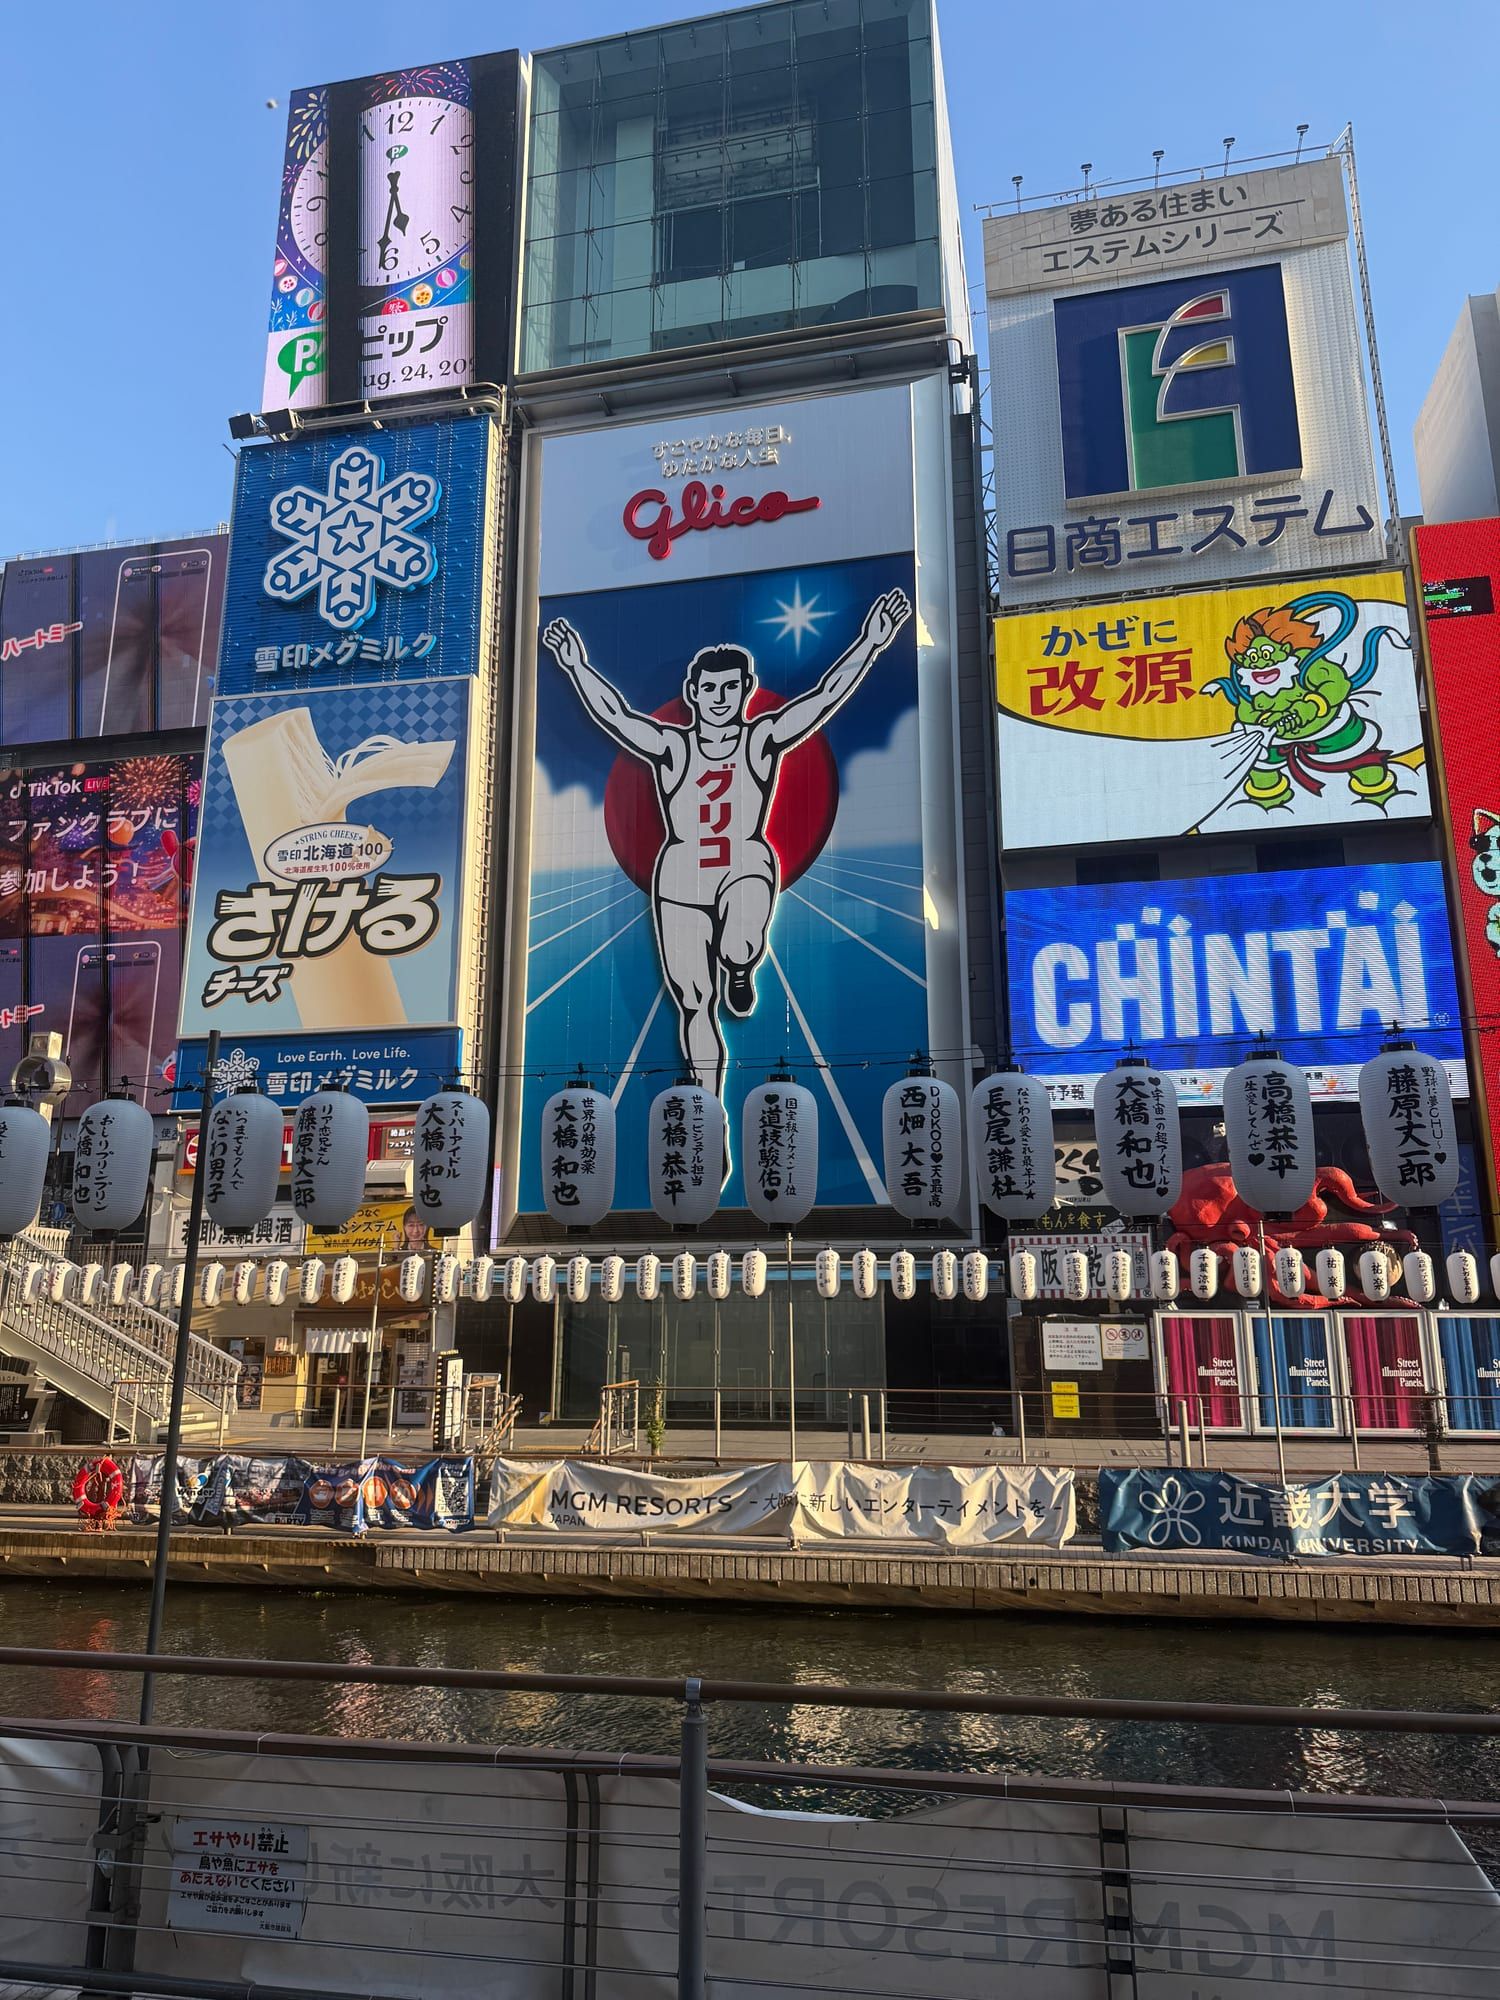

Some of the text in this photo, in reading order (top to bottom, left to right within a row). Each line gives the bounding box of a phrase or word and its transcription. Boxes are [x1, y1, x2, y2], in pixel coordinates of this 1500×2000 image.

[385, 110, 414, 134] 12
[429, 115, 446, 136] 1
[450, 203, 473, 224] 4
[1069, 185, 1248, 235] 夢ある住まい
[382, 248, 399, 271] 6
[420, 230, 441, 255] 5
[1042, 210, 1287, 274] エステムシリーズ
[362, 315, 449, 362] ピップ
[363, 372, 396, 390] ug.
[400, 363, 433, 382] 24,
[662, 446, 779, 478] ゆたかな人生
[1007, 489, 1374, 579] 日商エステム
[0, 621, 83, 661] ハートミー
[254, 631, 437, 673] 雪印メグミルク
[1041, 614, 1178, 658] かぜに
[1026, 646, 1200, 717] 改源
[29, 778, 109, 798] TikTok LIVE
[8, 806, 179, 842] ファンクラブに
[299, 829, 359, 845] STRING CHEESE
[695, 763, 737, 870] グリコ
[207, 873, 442, 962] さける
[202, 964, 294, 1008] チーズ
[277, 1046, 411, 1064] Love Earth. Love Life.
[267, 1065, 419, 1096] 雪印メグミルク
[316, 1103, 334, 1166] リア恋兄さん
[446, 1100, 465, 1179] スーパーアイドル
[581, 1097, 597, 1175] 世界の特効薬
[899, 1085, 927, 1197] 西畑大吾
[982, 1086, 1024, 1200] 長尾謙杜
[1114, 1076, 1156, 1189] 大橋和也
[1261, 1070, 1298, 1180] 高橋恭平
[1387, 1064, 1436, 1188] 藤原丈一郎
[74, 1115, 97, 1204] 大橋和也
[207, 1109, 233, 1204] なにわ男子
[295, 1105, 318, 1210] 藤原丈一郎
[419, 1102, 446, 1208] 大橋和也
[551, 1098, 581, 1207] 大橋和也
[661, 1096, 689, 1207] 高橋恭平
[758, 1104, 786, 1189] 道枝駿佑
[1212, 1357, 1234, 1368] Street
[1214, 1376, 1239, 1387] Panels.
[1303, 1357, 1326, 1368] Street
[1306, 1376, 1331, 1387] Panels.
[1397, 1357, 1419, 1368] Street
[1399, 1376, 1425, 1388] Panels.
[550, 1489, 733, 1517] MGM RESORTS
[550, 1512, 586, 1527] JAPAN
[1218, 1479, 1416, 1530] 近畿大学
[1221, 1533, 1419, 1554] KINDAI UNIVERSITY
[192, 1831, 289, 1854] エサやり禁止
[180, 1871, 295, 1893] あたえないでください
[199, 1855, 280, 1876] 鳥や魚にエサを
